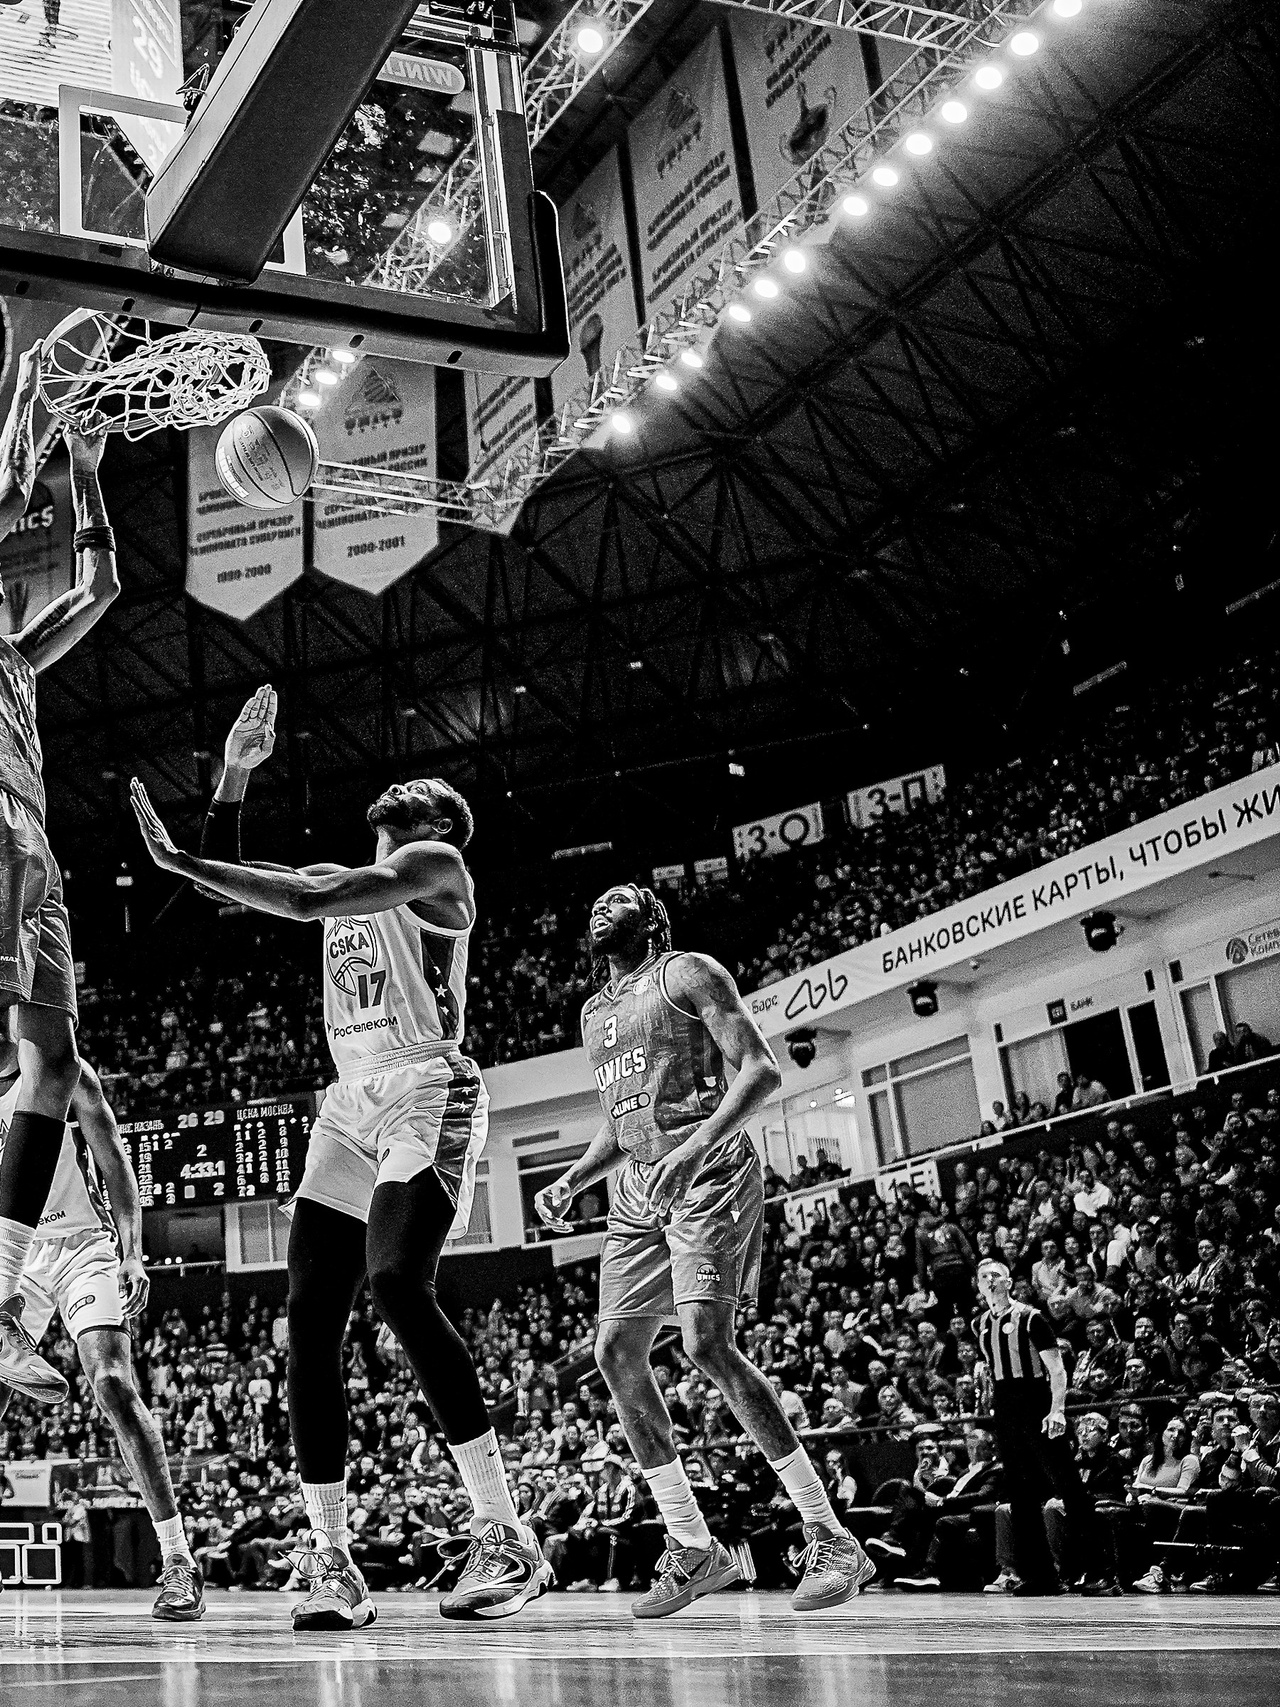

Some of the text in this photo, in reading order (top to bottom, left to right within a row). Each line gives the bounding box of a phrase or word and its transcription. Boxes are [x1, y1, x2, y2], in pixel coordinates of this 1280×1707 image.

[11, 505, 54, 533] ICS
[881, 895, 1027, 974] БАНКОВСКИЕ
[1032, 856, 1124, 912] КАРТЫ,
[1128, 808, 1227, 867] ЧТОБЫ
[329, 931, 370, 959] CSKA
[357, 970, 386, 1009] 17
[603, 1014, 618, 1049] 3
[594, 1045, 647, 1092] UNICS
[178, 1110, 225, 1129] 26 29
[164, 1139, 173, 1150] 2
[196, 1144, 207, 1157] 2
[213, 1182, 225, 1196] 2
